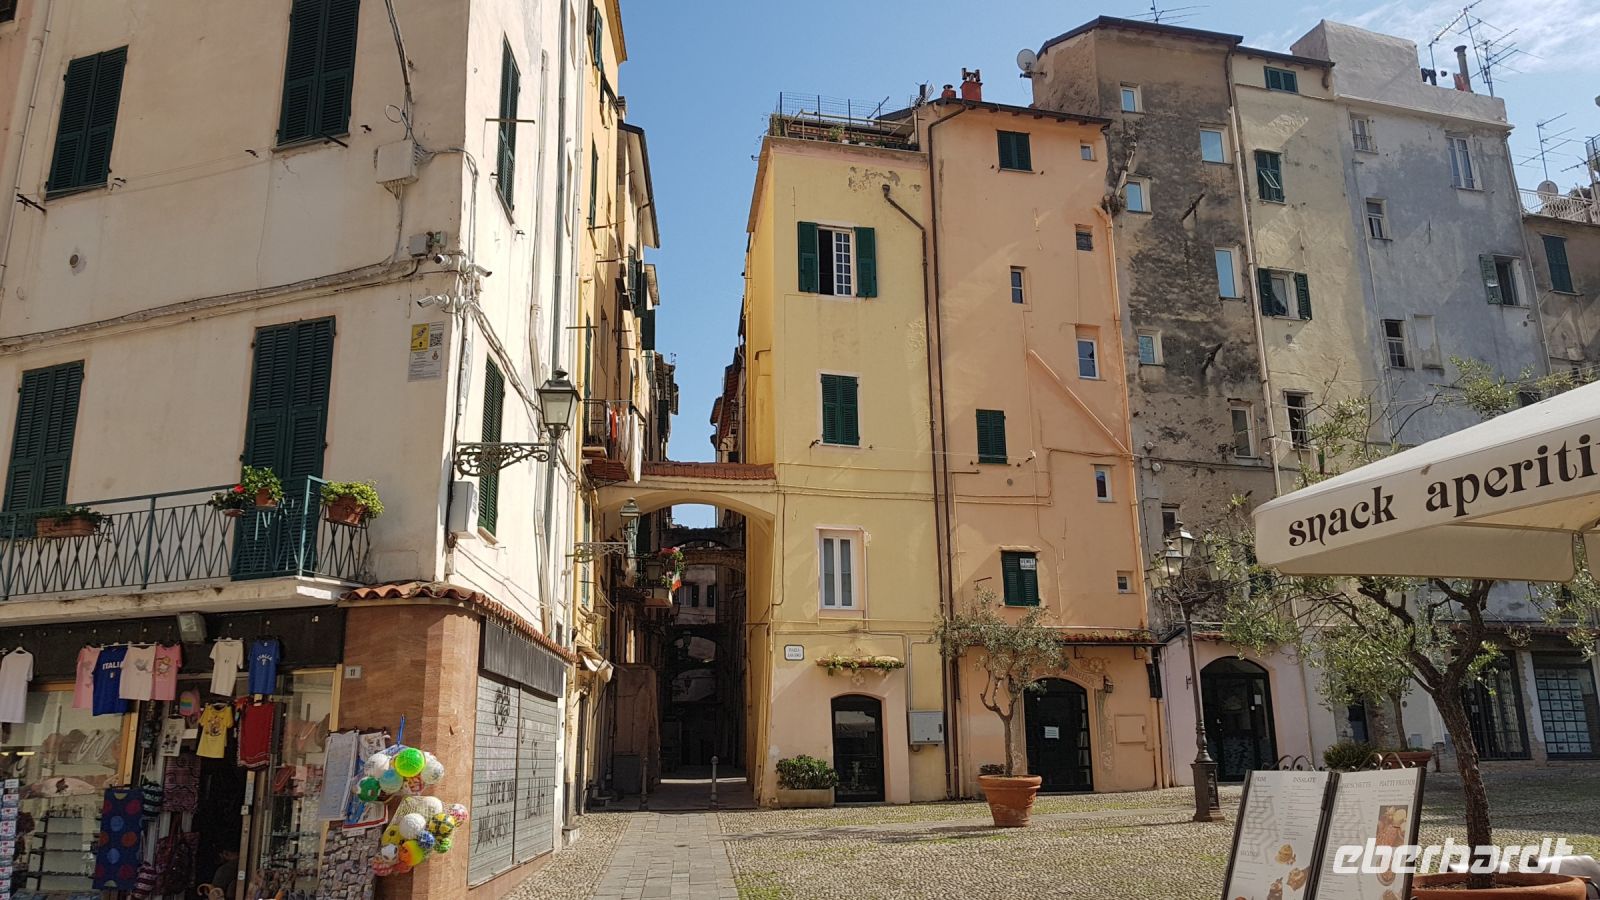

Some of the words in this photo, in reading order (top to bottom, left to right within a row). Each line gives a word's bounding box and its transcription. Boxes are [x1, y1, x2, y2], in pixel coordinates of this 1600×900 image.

[1288, 485, 1398, 546] snack
[1425, 433, 1600, 518] aperiti
[102, 661, 122, 670] ITALI
